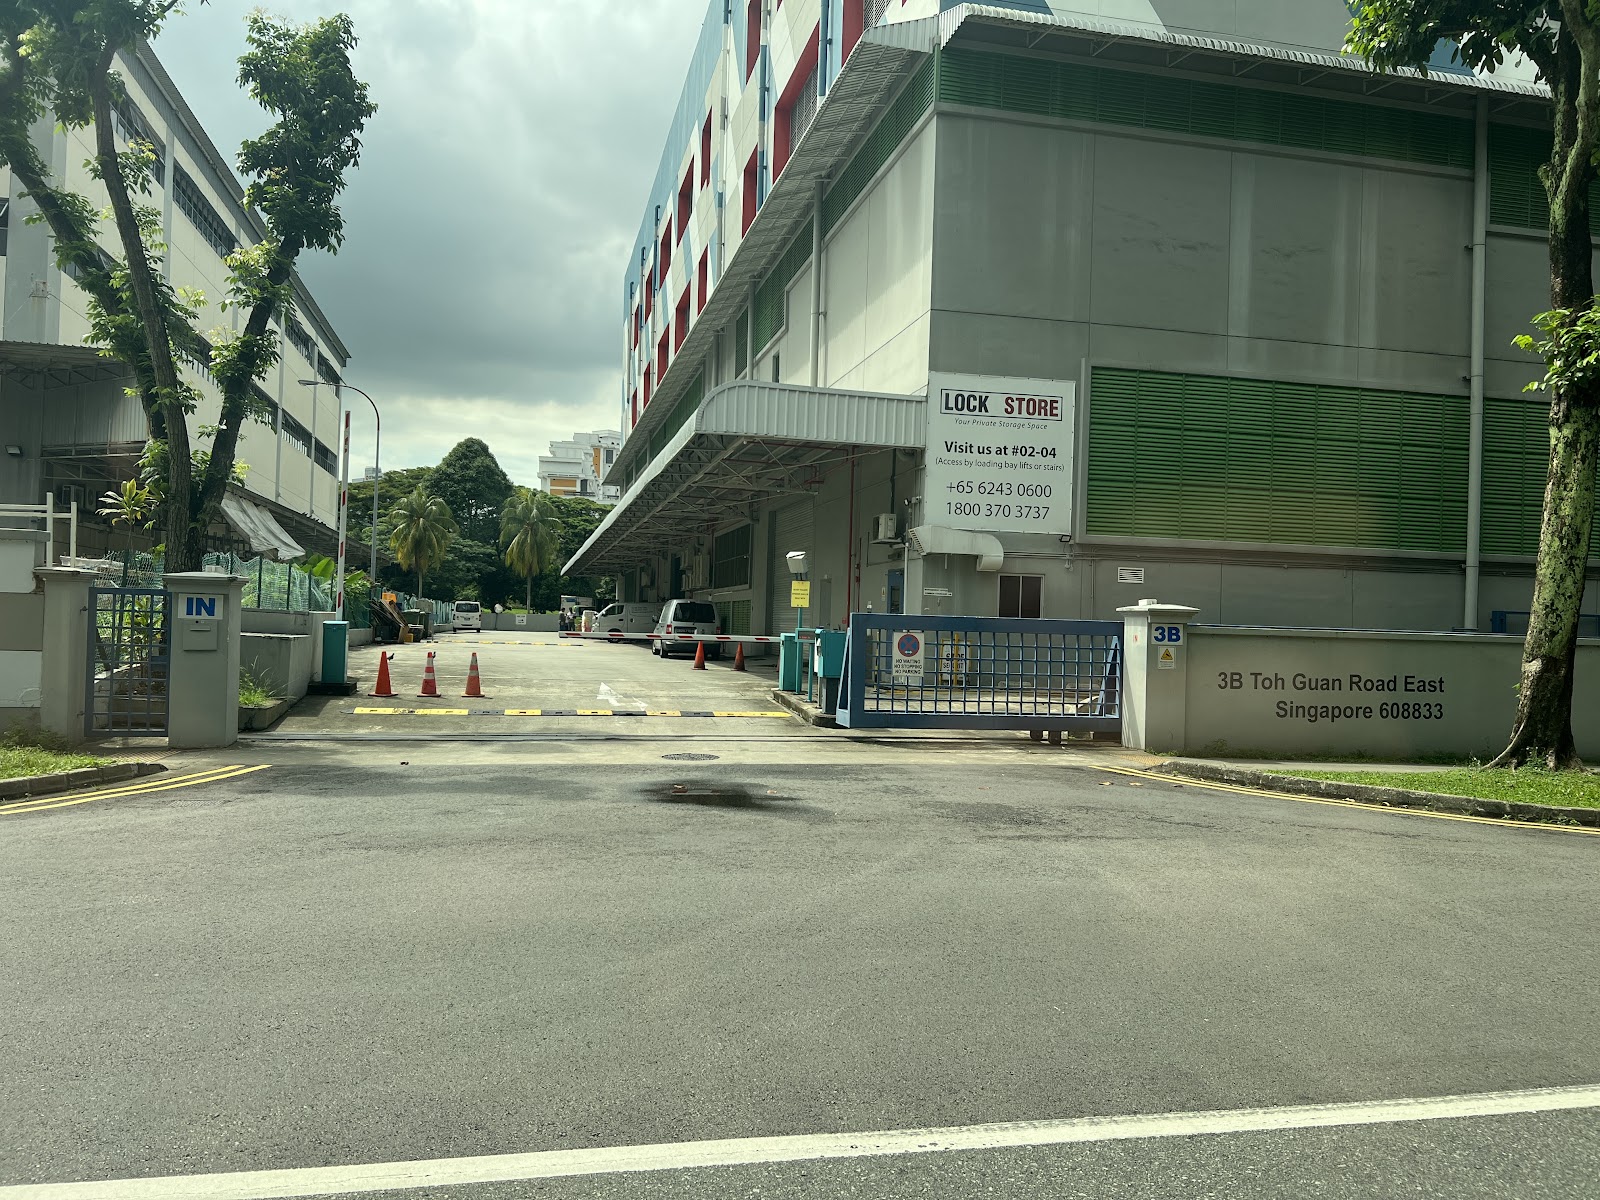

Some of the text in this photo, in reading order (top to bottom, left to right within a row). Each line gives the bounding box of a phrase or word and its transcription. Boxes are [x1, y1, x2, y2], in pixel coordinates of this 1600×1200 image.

[944, 393, 1059, 417] LOCK STORE
[971, 418, 996, 427] Private
[998, 420, 1025, 429] Storage
[1027, 422, 1048, 430] Space
[944, 440, 1057, 458] Visit us at #02-04
[935, 456, 962, 466] (Access
[964, 458, 974, 468] by
[975, 459, 1003, 469] loading
[1004, 461, 1018, 470] bay
[1019, 461, 1033, 470] lifts
[1043, 463, 1065, 472] stairs)
[946, 481, 1052, 498] +65 6243 0600
[946, 502, 1050, 520] 1800 370 3737
[186, 597, 216, 616] IN
[1154, 626, 1181, 642] 3B
[1217, 672, 1445, 693] 3B Toh Guan Road East
[1275, 700, 1444, 723] Singapore 608833
